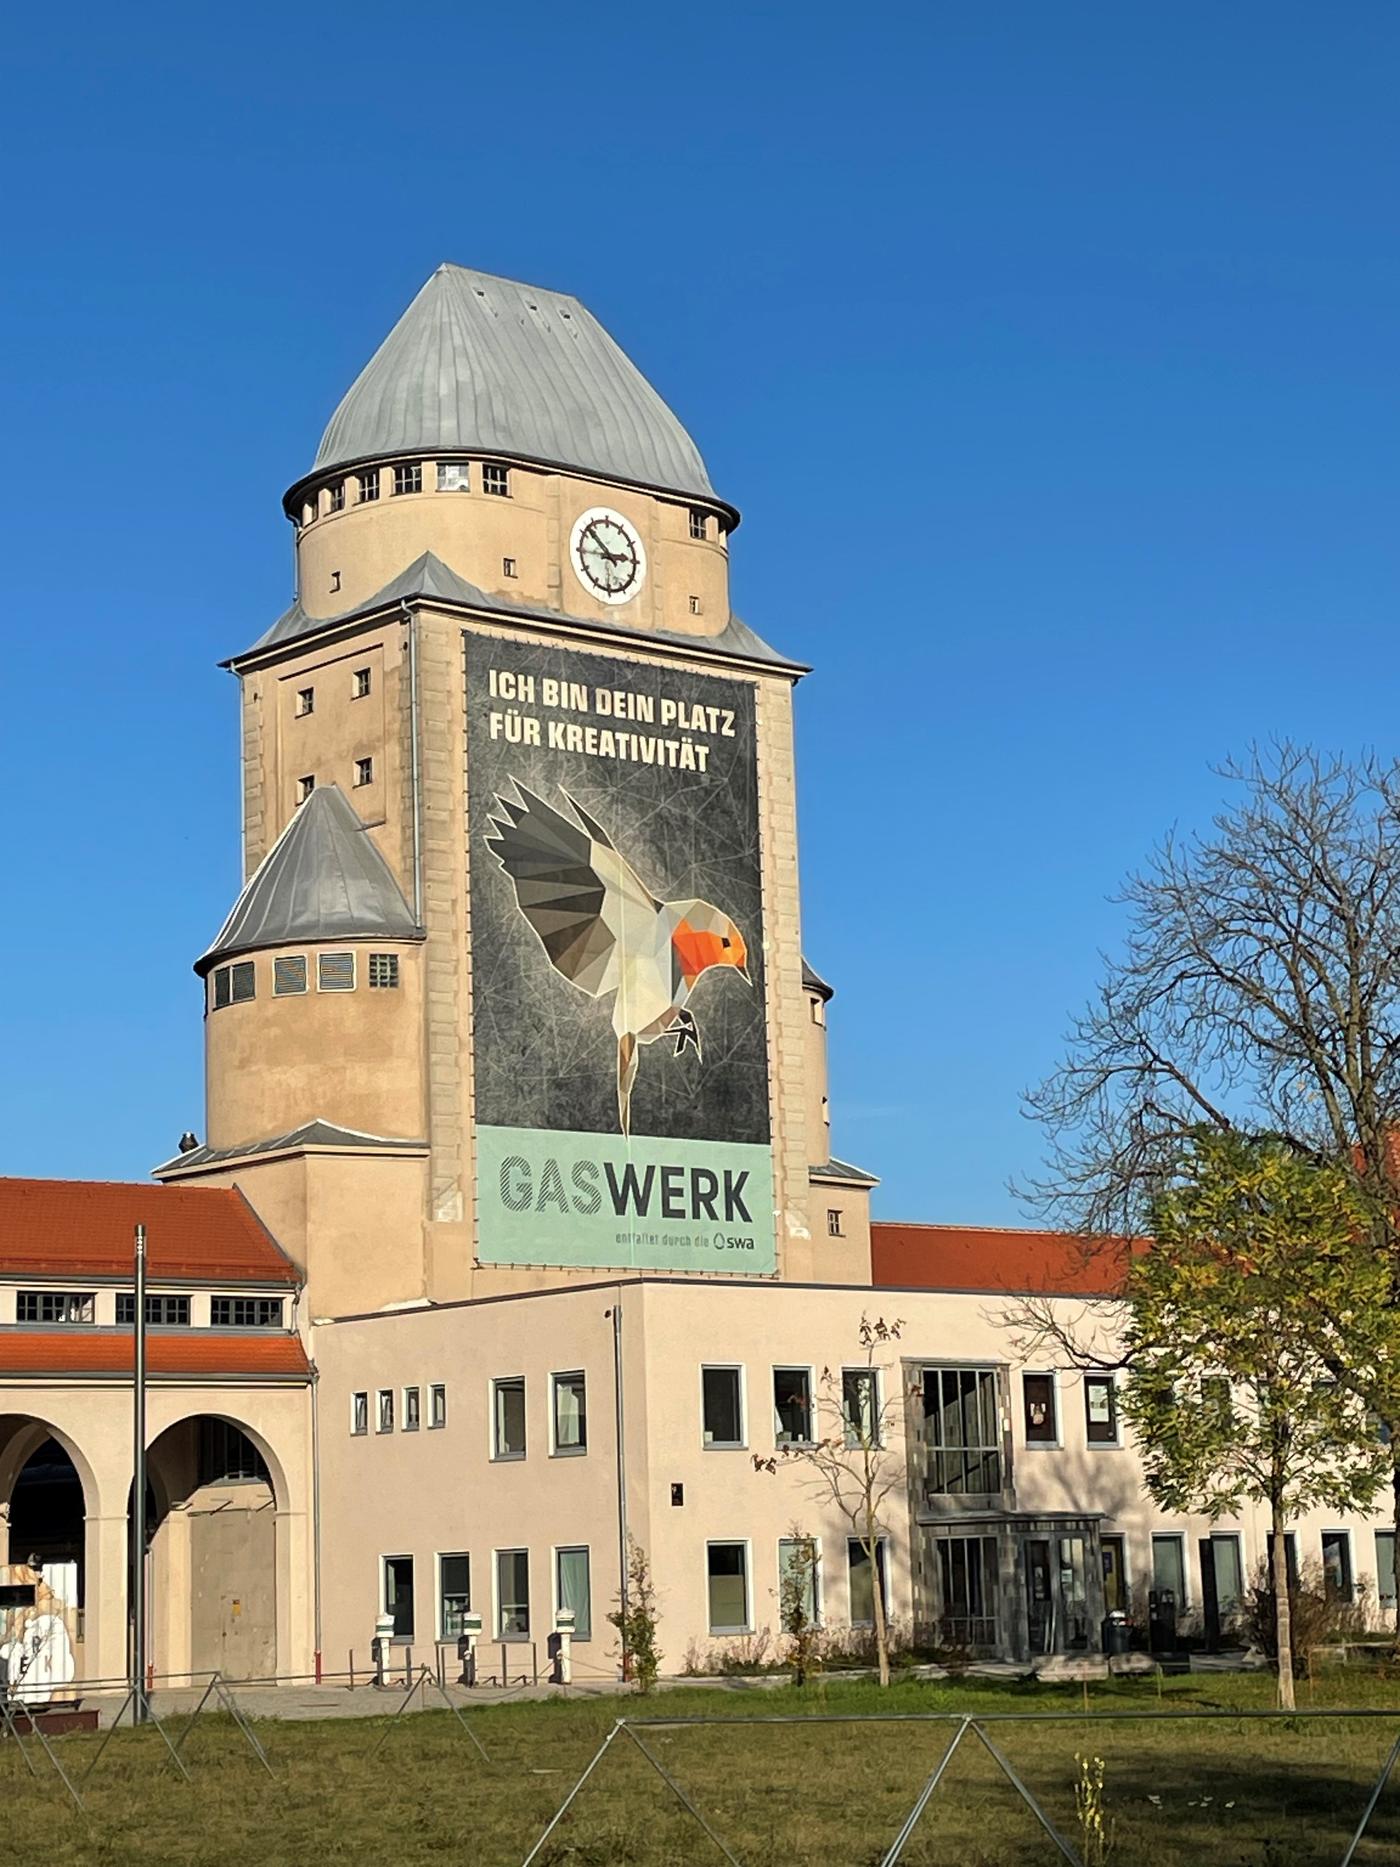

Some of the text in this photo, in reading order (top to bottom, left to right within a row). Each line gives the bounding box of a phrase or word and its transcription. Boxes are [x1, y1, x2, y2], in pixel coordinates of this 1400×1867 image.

[489, 669, 736, 737] ICH BIN DEIN PLATZ
[489, 709, 710, 773] FÜR KREATIVITÄT
[500, 1155, 753, 1223] GASWERK
[615, 1232, 754, 1250] entfaltet durch die swa
